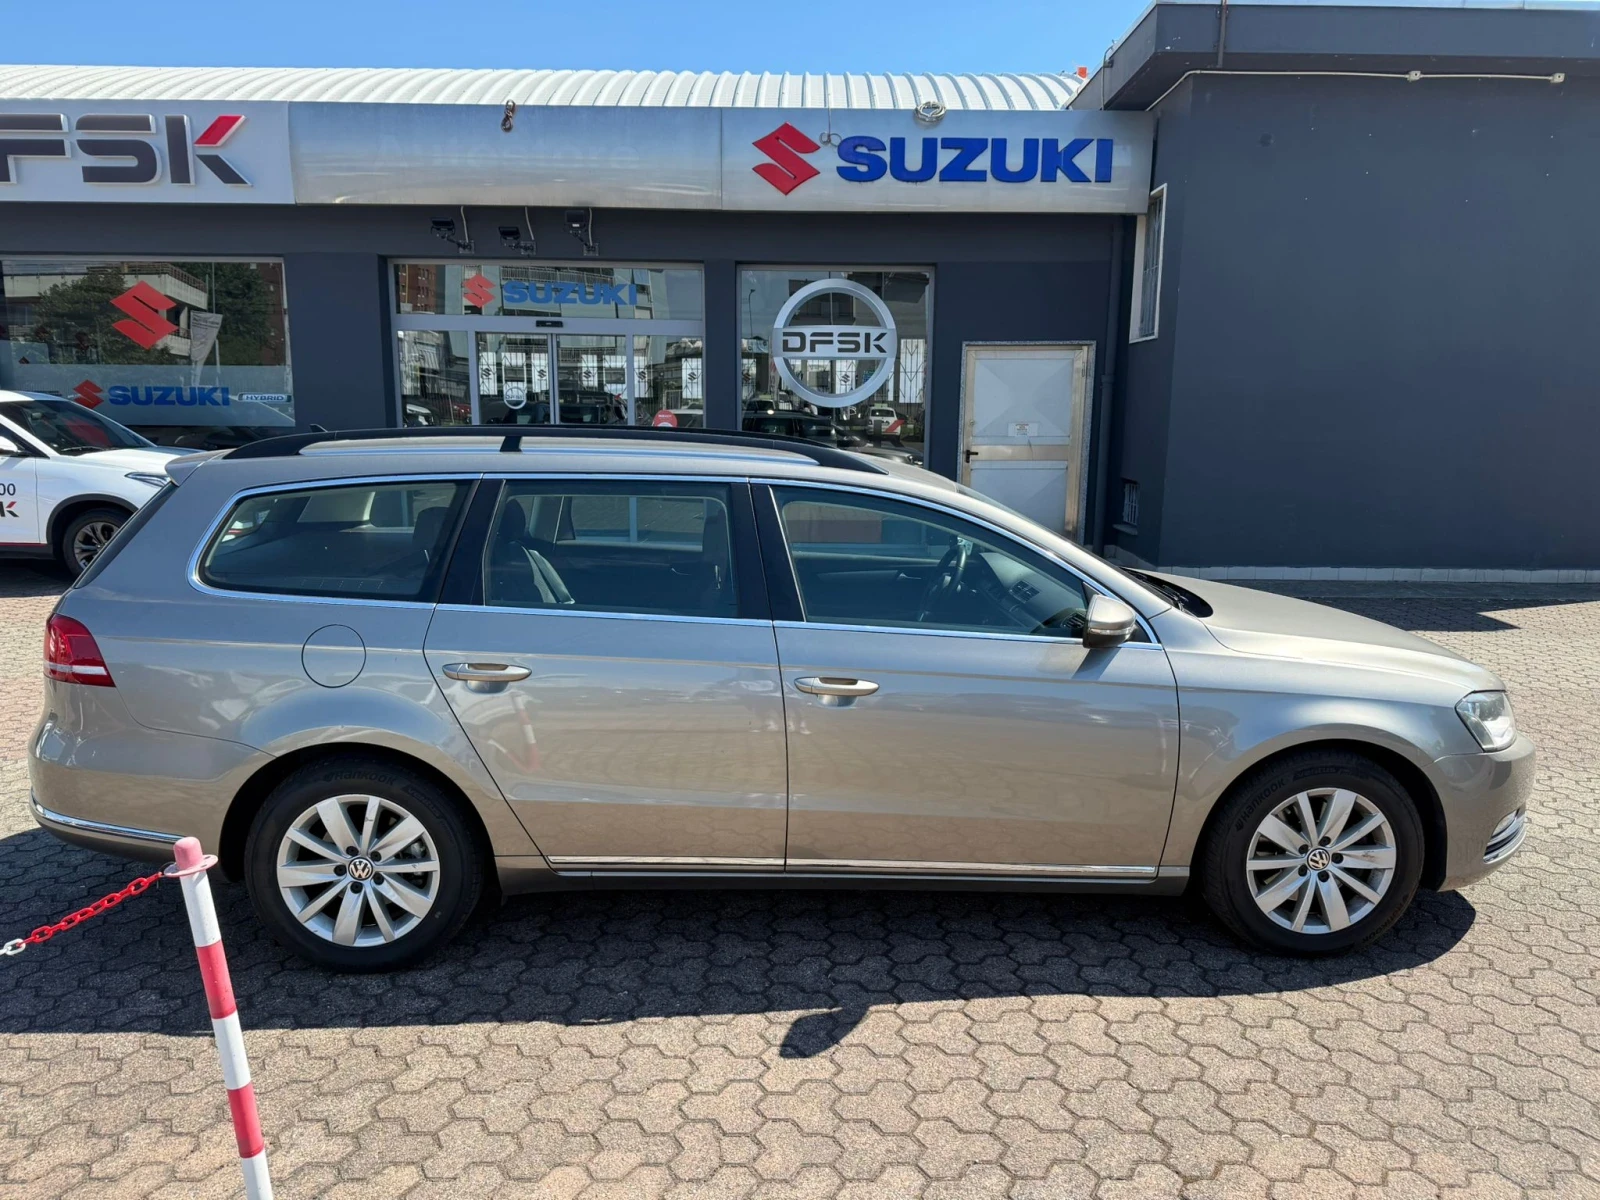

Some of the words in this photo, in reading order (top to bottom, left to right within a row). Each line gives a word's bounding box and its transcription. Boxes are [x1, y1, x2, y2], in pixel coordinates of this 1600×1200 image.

[836, 135, 1113, 183] SUZUKI
[503, 280, 637, 306] SUZUKI
[782, 331, 888, 354] DFSK
[108, 385, 230, 407] SUZUKI
